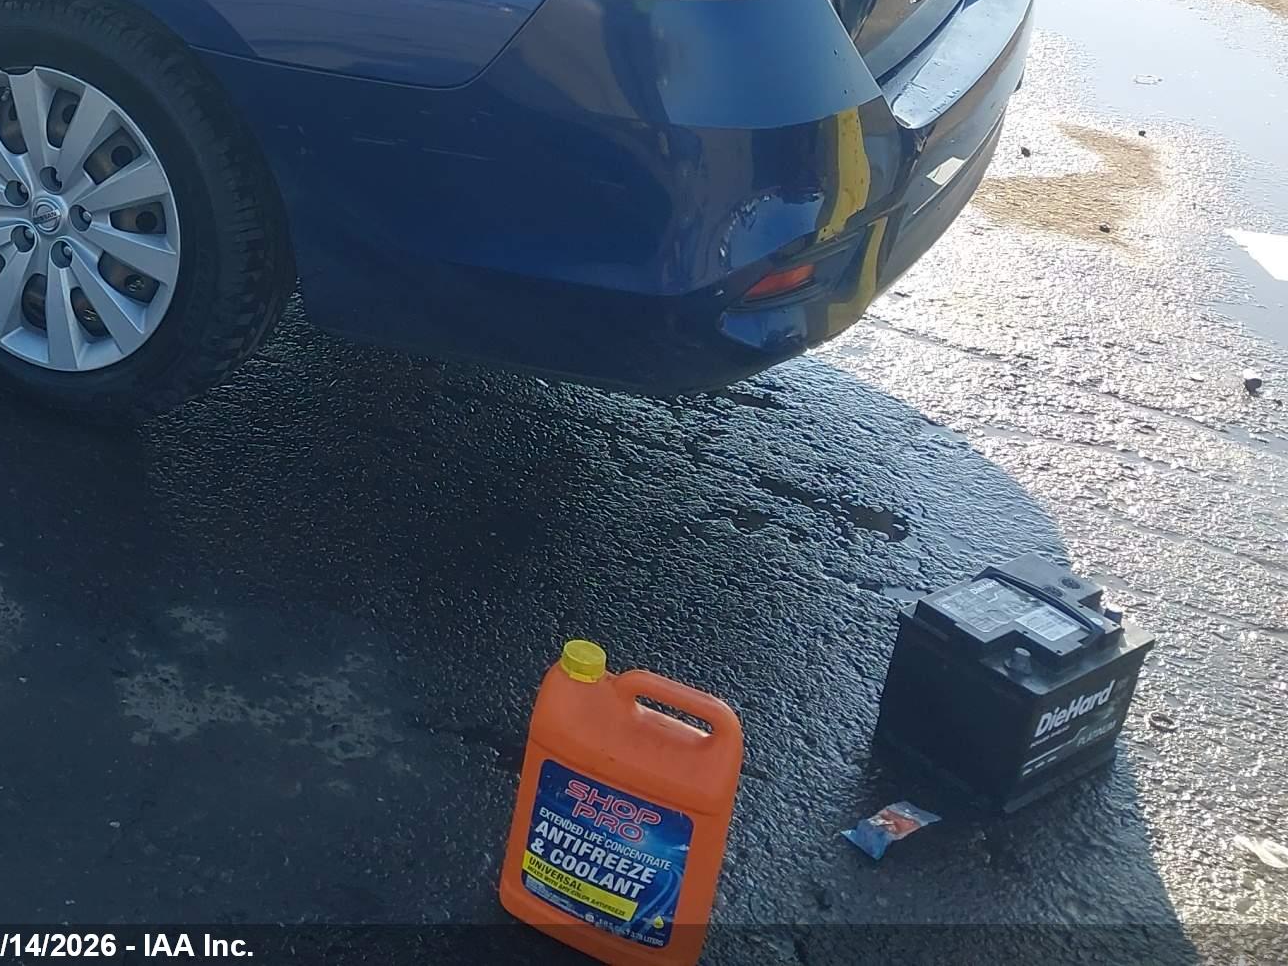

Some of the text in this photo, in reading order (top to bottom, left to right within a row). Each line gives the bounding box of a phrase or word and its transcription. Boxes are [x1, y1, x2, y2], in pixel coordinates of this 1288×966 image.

[1034, 679, 1116, 738] DieHard
[564, 779, 662, 825] SHOP
[572, 801, 644, 843] PRO
[530, 837, 545, 856] &
[549, 848, 646, 899] COOLANT
[535, 820, 657, 884] ANTIFREEZE
[539, 806, 673, 871] EXTENDED LIFE CONCENTRATE
[529, 856, 583, 892] UNIVERSAL
